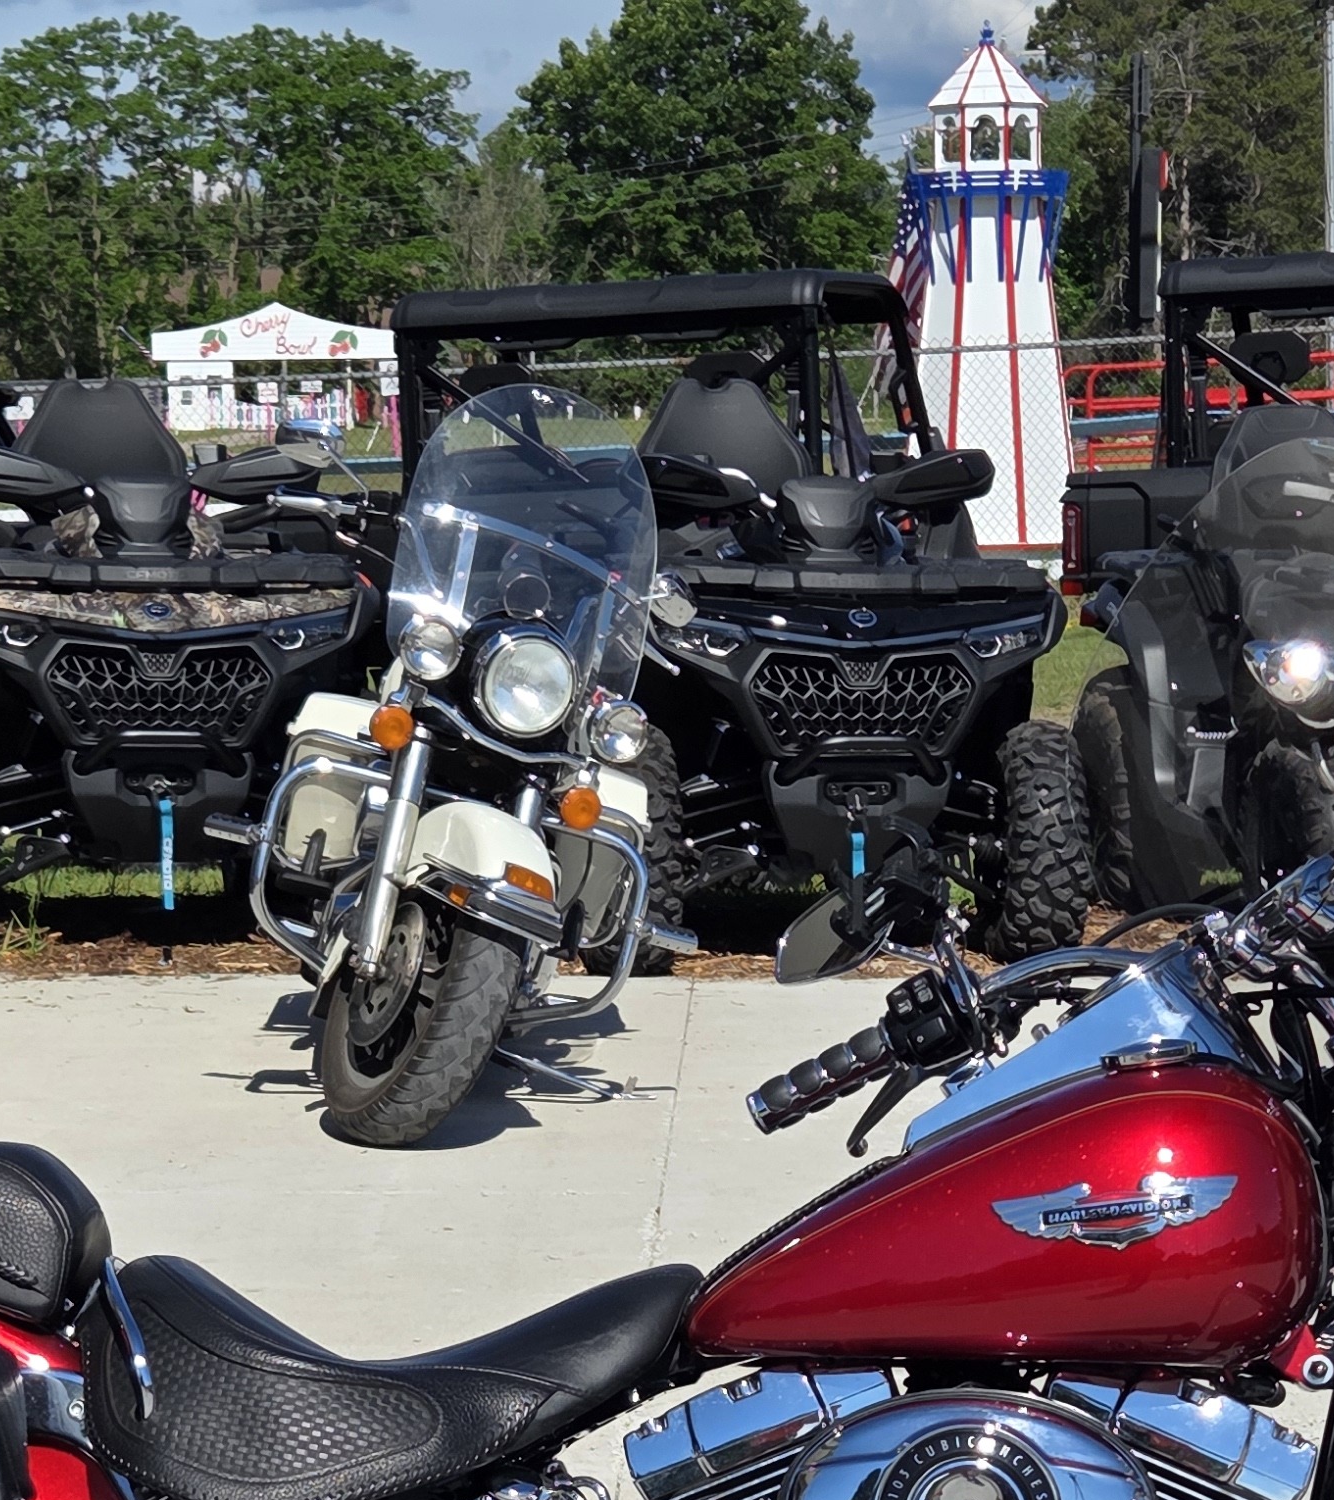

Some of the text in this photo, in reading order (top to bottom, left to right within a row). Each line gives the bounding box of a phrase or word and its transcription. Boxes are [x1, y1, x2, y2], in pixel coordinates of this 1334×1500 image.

[239, 313, 291, 338] Cherry
[276, 336, 317, 355] Bowl
[887, 1435, 1048, 1500] 103 CUBIC NCHES
